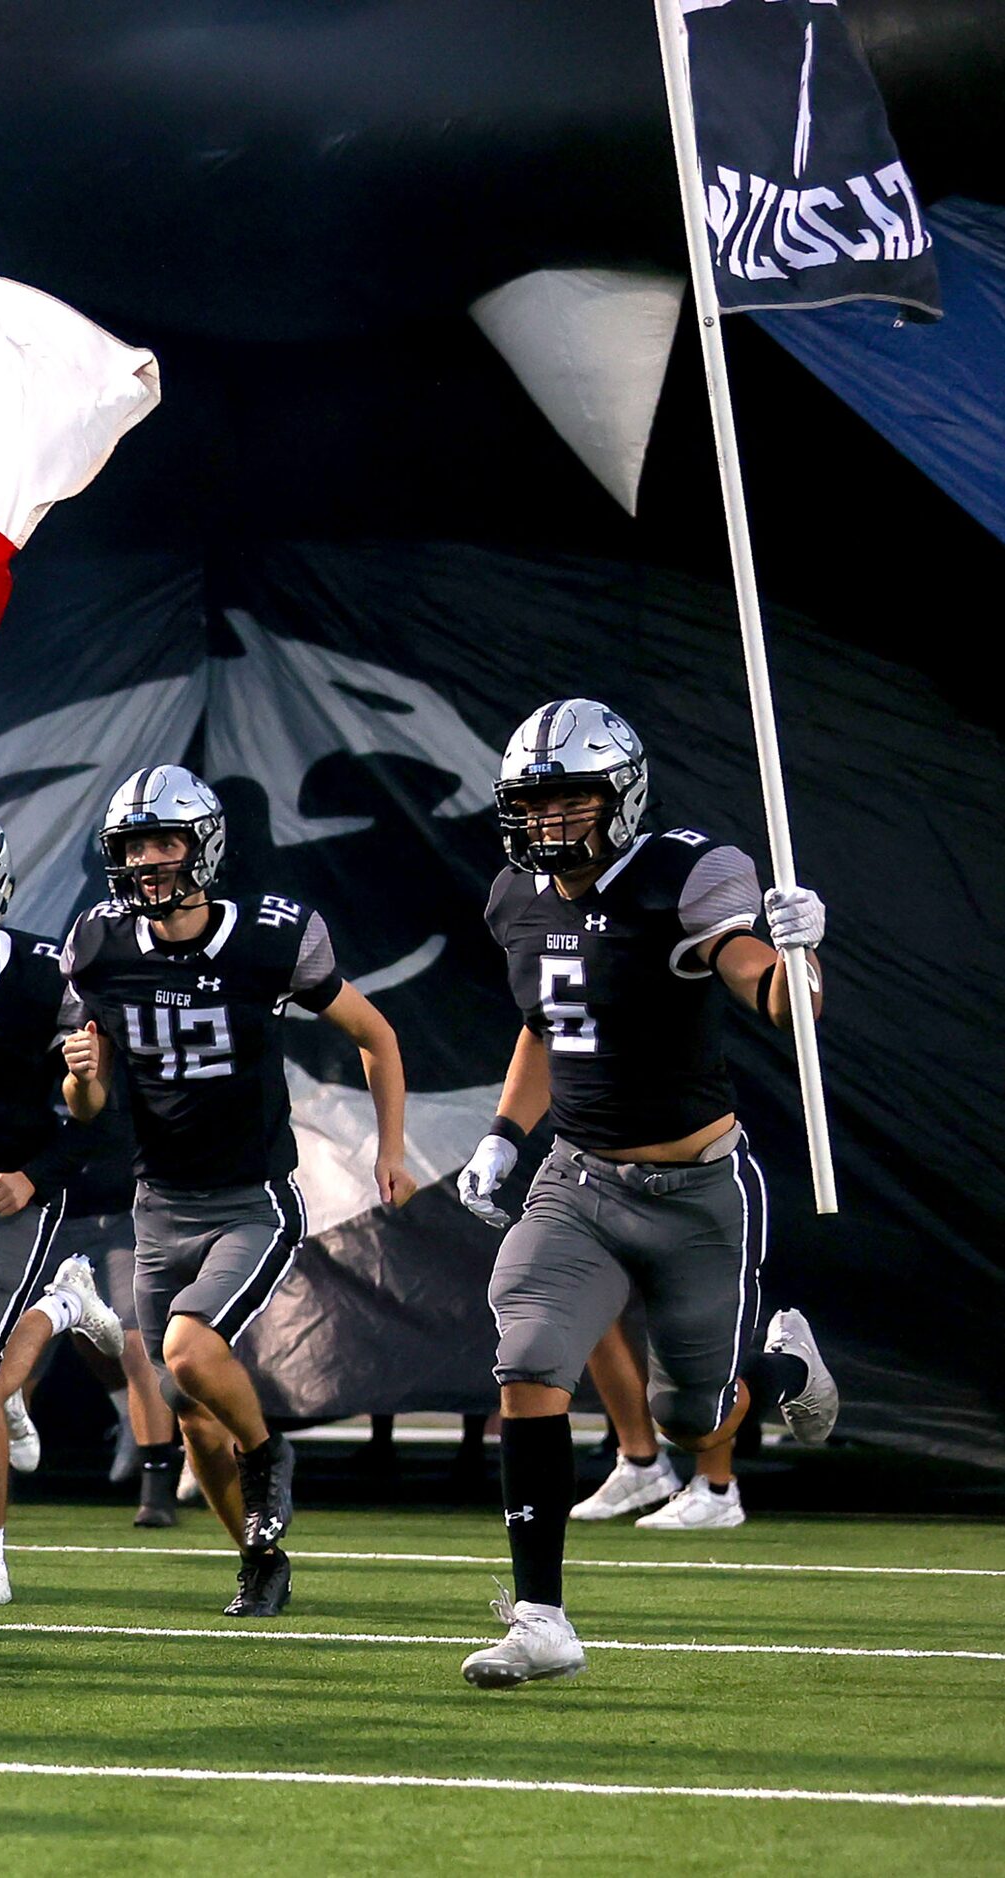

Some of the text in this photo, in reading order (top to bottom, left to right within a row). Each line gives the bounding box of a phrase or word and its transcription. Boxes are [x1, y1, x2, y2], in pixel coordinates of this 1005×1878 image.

[257, 893, 301, 928] 42
[546, 933, 579, 951] GUYER
[155, 989, 192, 1008] GUYER
[539, 955, 598, 1055] 6
[124, 1004, 233, 1081] 42
